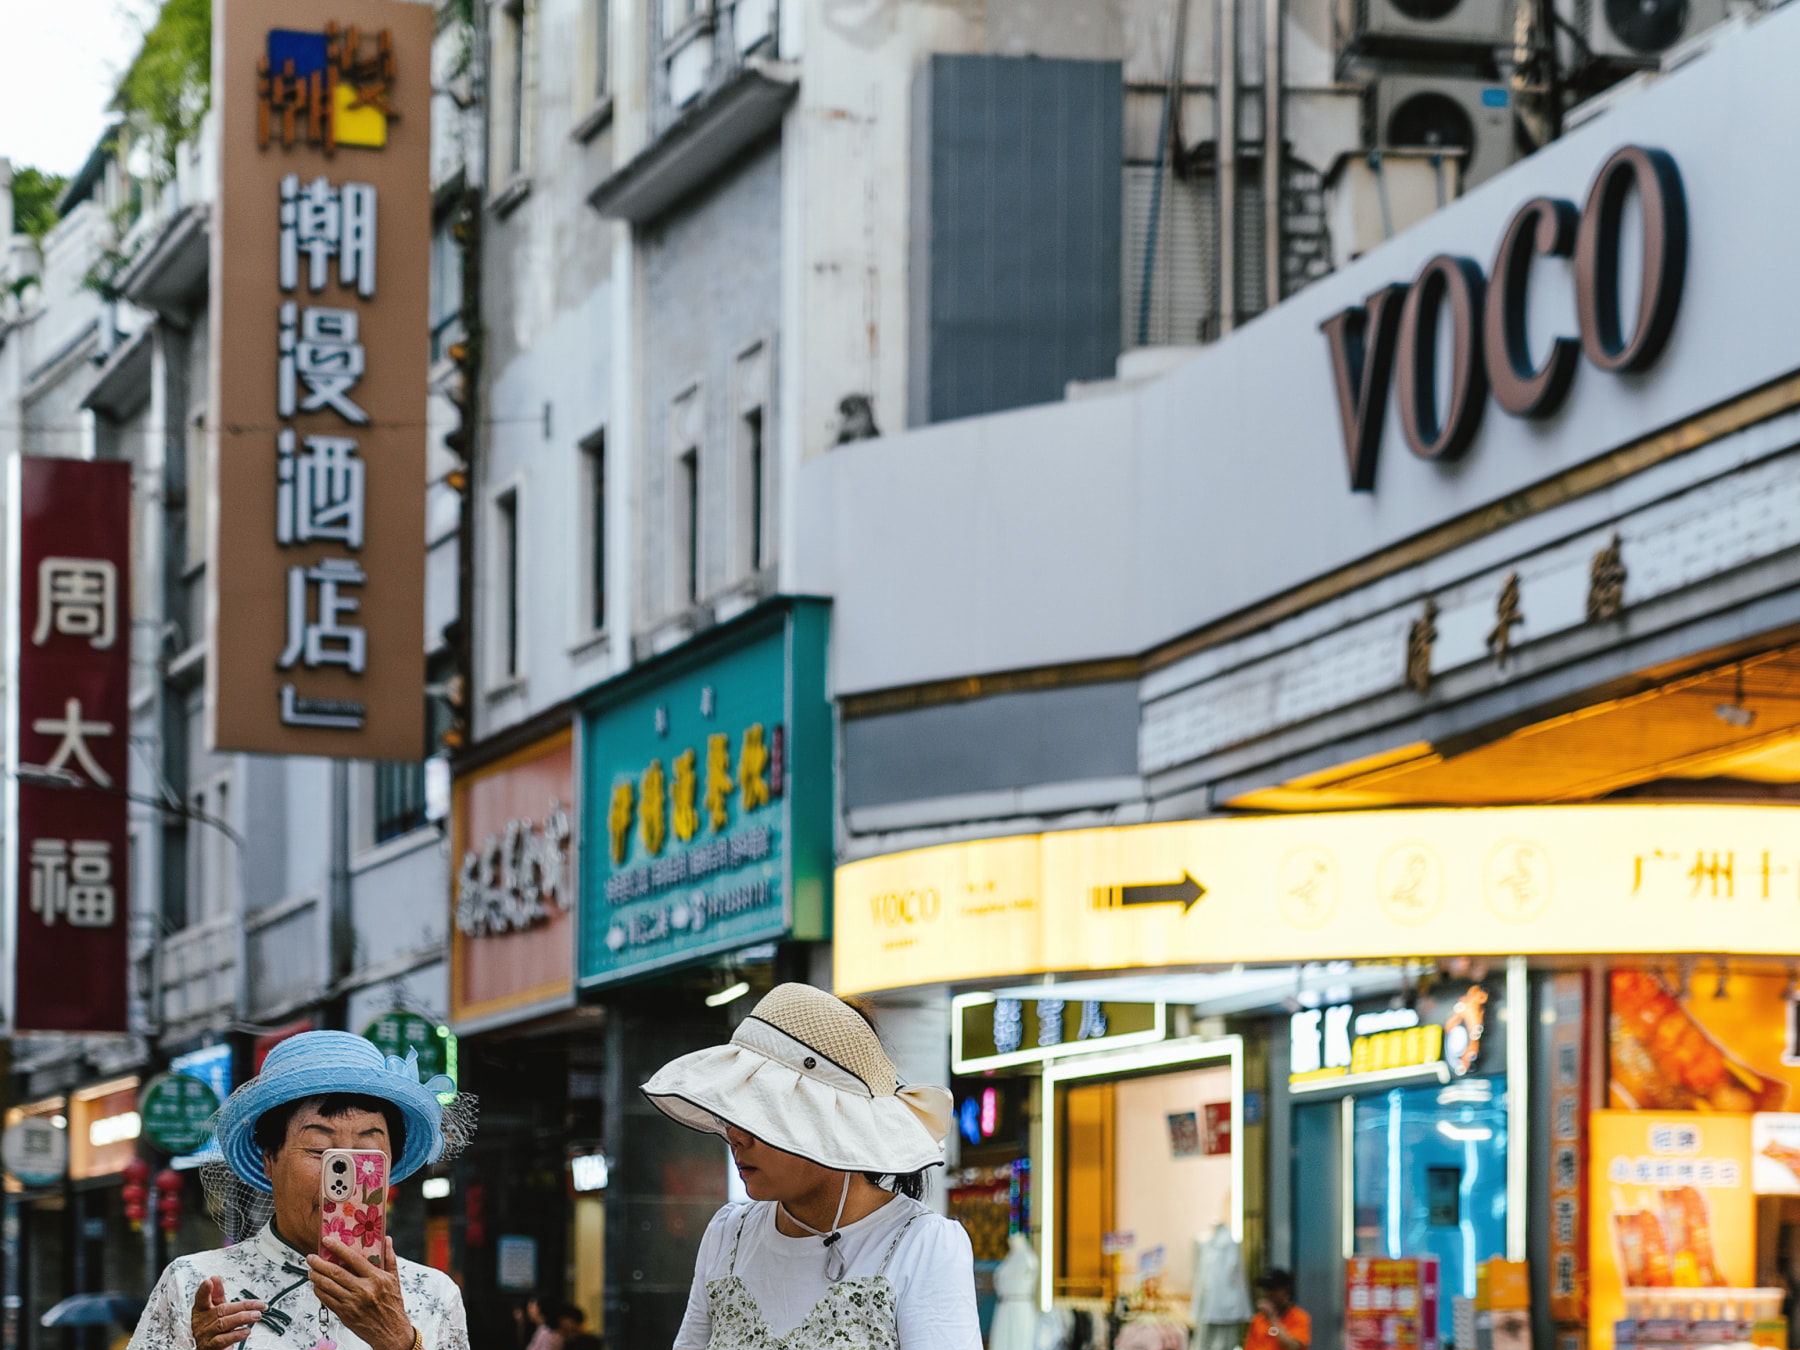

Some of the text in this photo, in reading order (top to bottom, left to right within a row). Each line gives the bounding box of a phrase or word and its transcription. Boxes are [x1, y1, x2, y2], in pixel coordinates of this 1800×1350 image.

[276, 173, 378, 676] 潮漫酒店
[1319, 144, 1689, 492] VOCO
[30, 557, 118, 927] 周大福
[1628, 844, 1800, 902] 广州十
